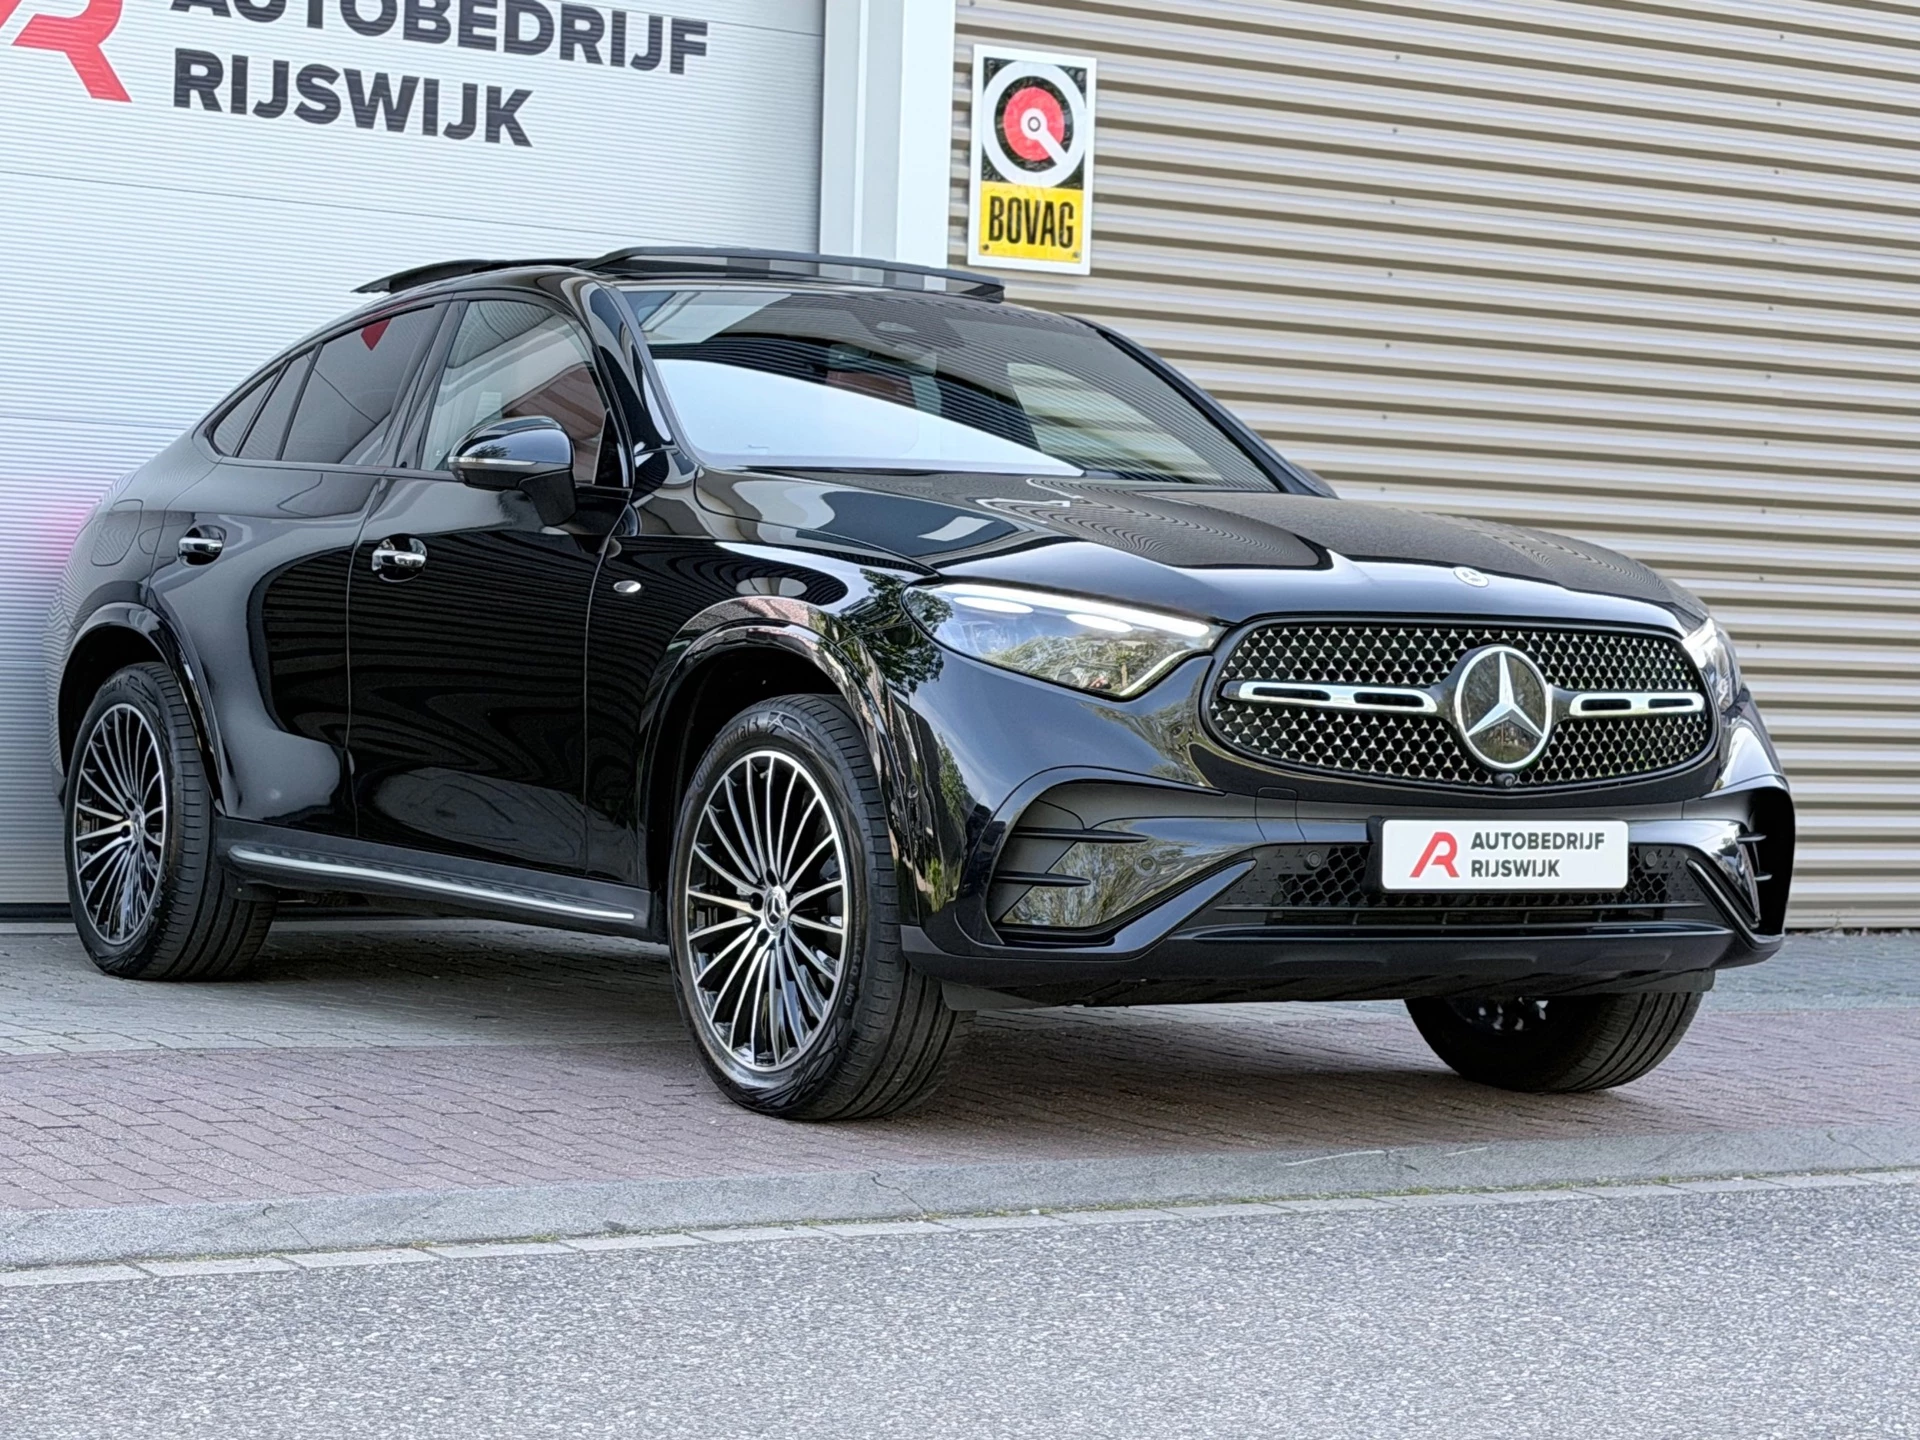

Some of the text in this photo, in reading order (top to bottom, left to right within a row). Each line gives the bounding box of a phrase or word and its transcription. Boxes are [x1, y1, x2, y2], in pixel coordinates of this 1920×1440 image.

[172, 47, 533, 148] RIJSWIJK
[988, 195, 1075, 249] BOVAG
[1470, 832, 1605, 850] AUTOBEDRIJF
[1470, 859, 1561, 878] RIJSWIJK
